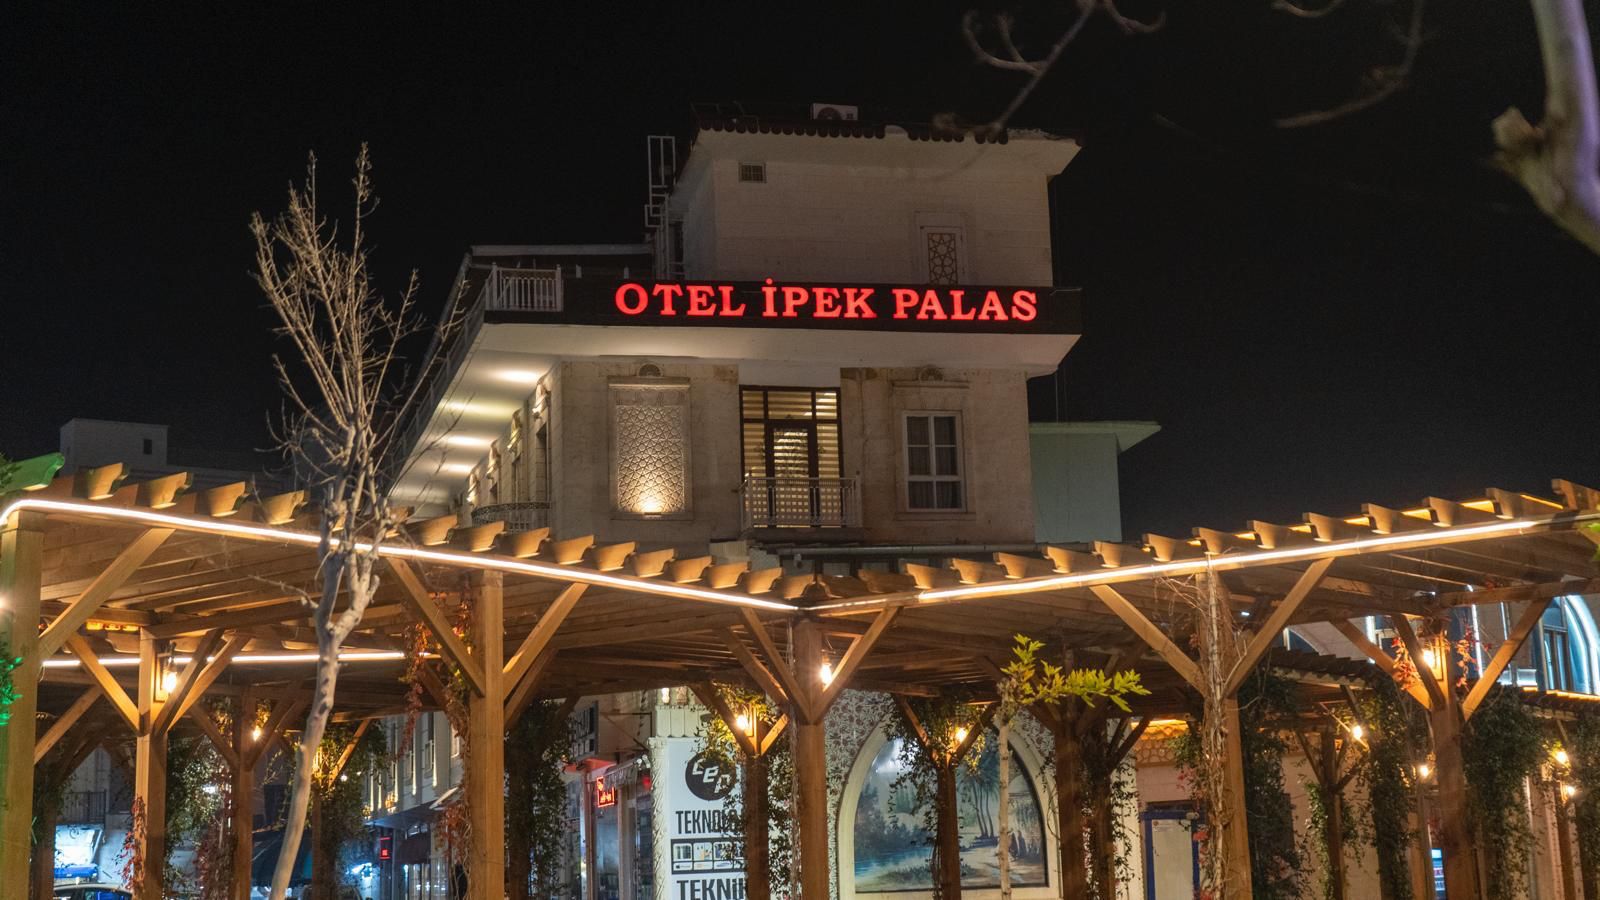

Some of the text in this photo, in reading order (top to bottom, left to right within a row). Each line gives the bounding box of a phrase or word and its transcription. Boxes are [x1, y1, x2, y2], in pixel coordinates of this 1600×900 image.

[614, 277, 1037, 322] OTEL İPEK PALAS
[675, 809, 745, 835] TEKNOLO
